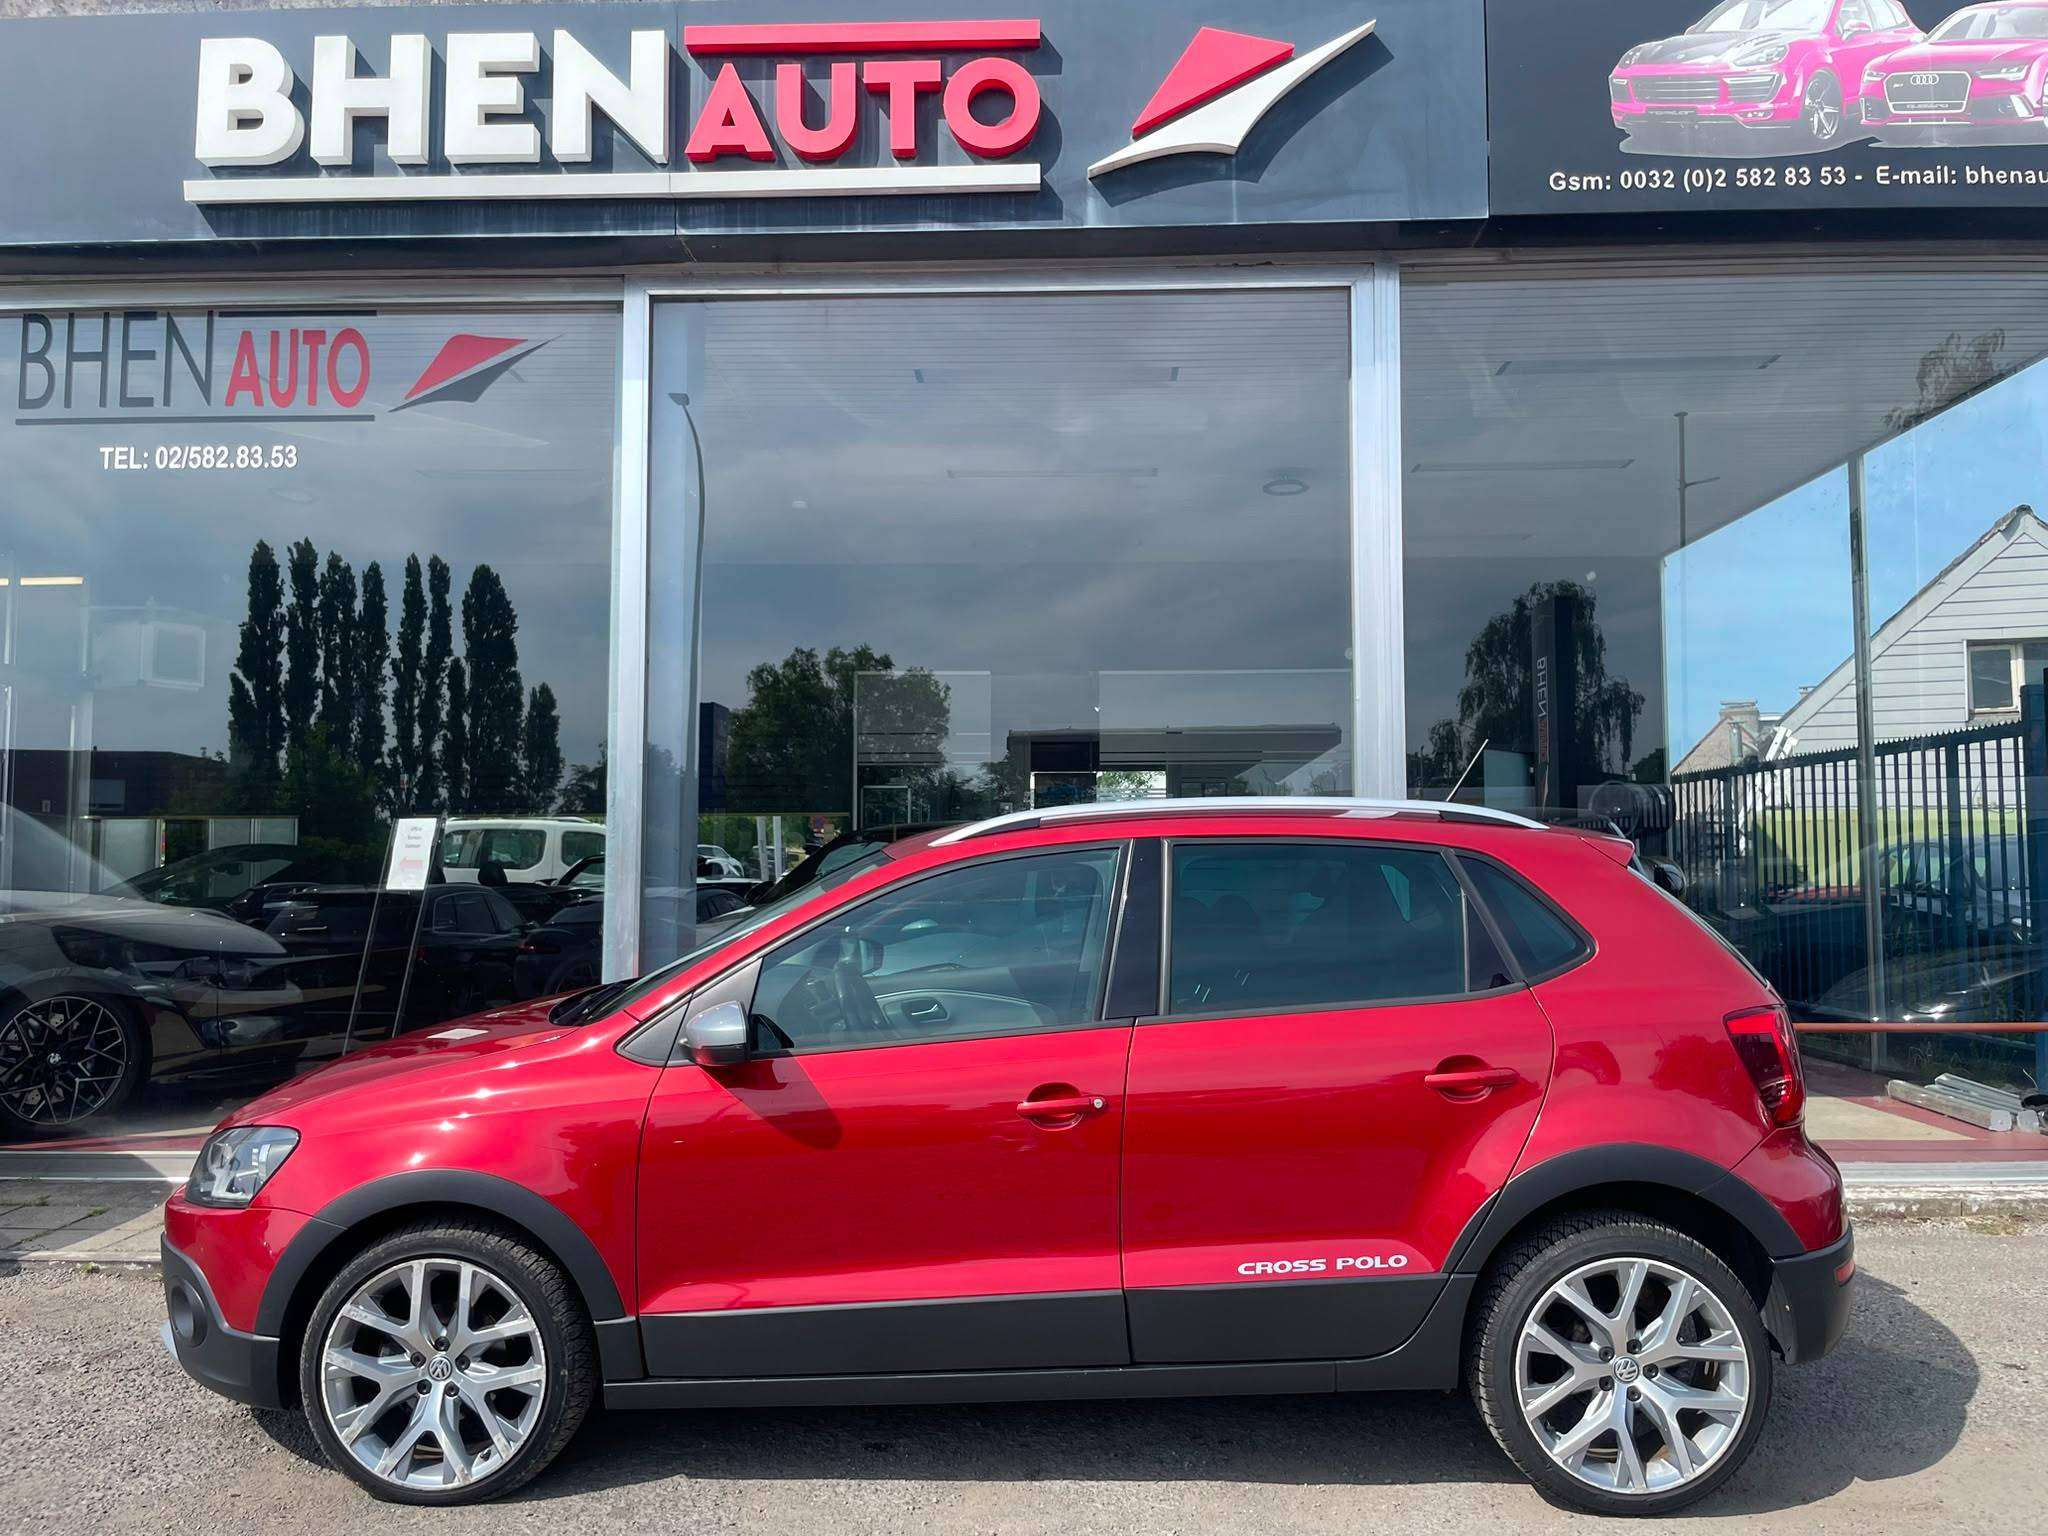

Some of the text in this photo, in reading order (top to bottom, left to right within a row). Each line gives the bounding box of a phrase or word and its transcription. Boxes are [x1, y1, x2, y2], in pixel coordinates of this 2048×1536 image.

[194, 29, 1041, 167] BHEN AUTO
[1549, 172, 1611, 191] Gsm:
[1620, 170, 1675, 189] 0032
[1683, 168, 1727, 192] (0)2
[1735, 168, 1776, 187] 582
[1784, 167, 1811, 186] 83
[1820, 166, 1846, 185] 53
[1876, 165, 1957, 185] E-mail:
[18, 310, 371, 410] BHEN AUTO
[99, 445, 298, 470] TEL: 02/582.83.53
[1237, 1254, 1408, 1275] CROSS POLO
